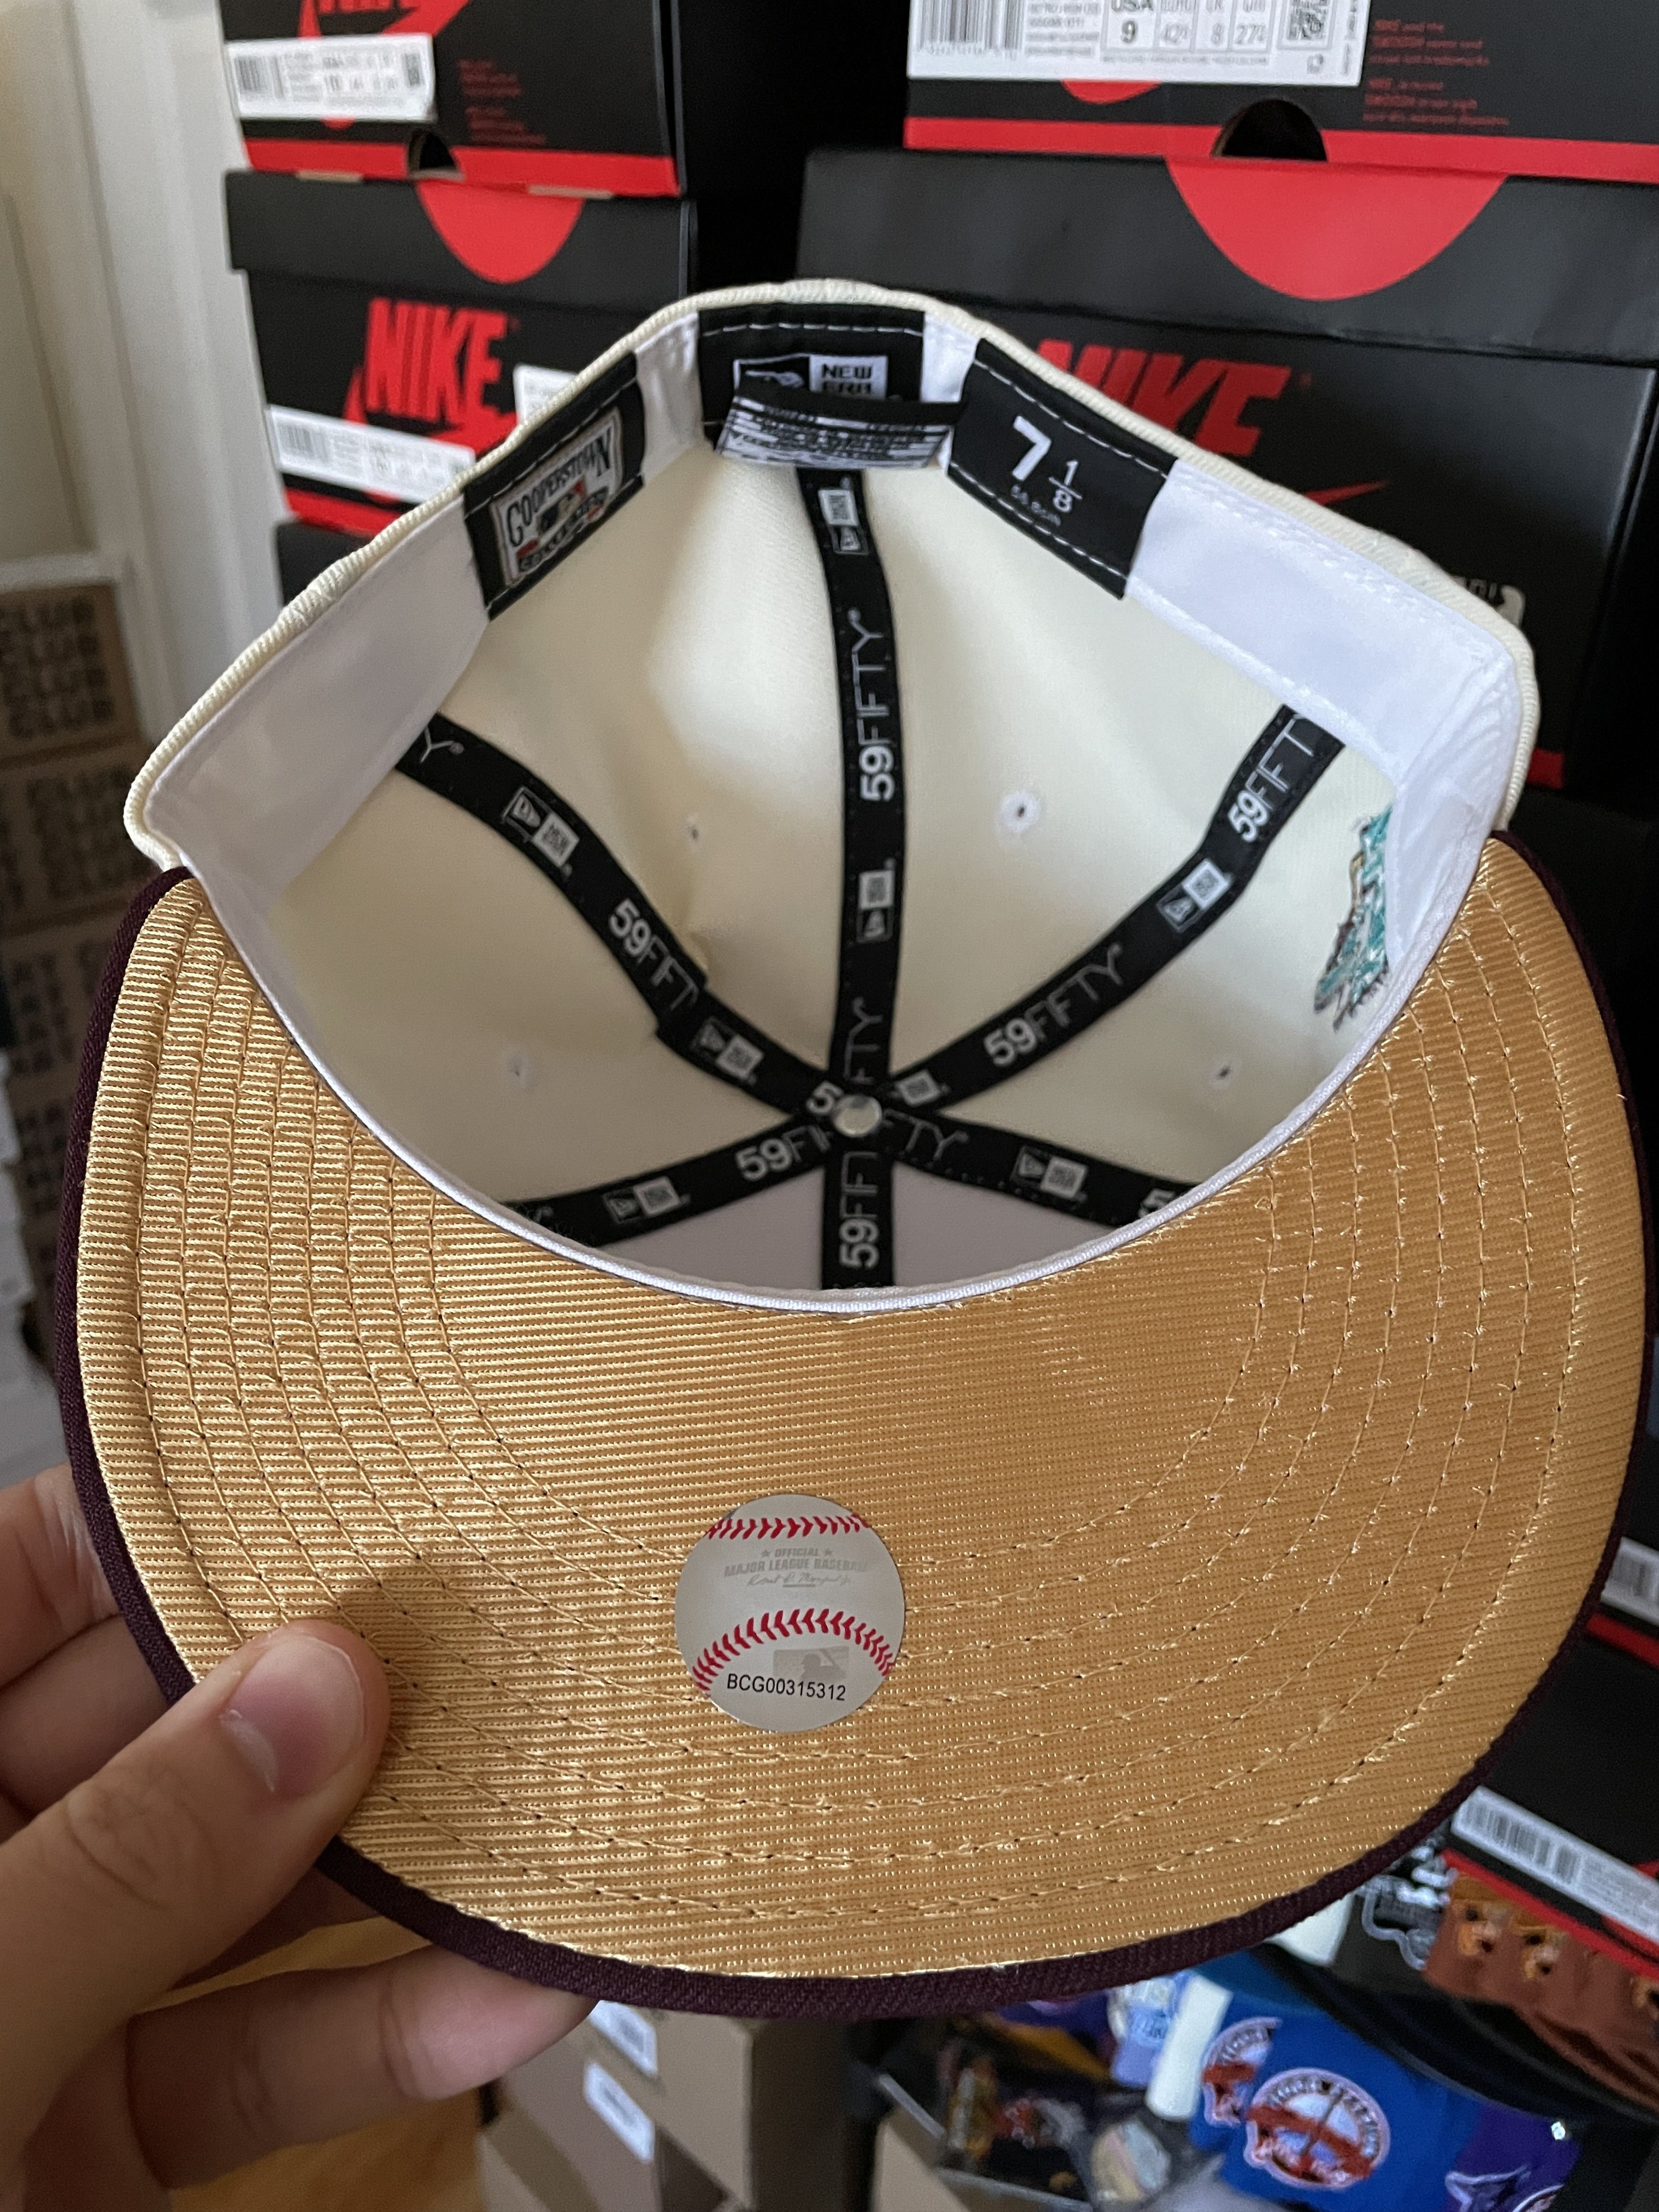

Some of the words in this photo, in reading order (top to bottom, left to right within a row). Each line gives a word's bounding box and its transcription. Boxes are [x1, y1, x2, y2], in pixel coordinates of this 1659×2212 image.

[1121, 20, 1137, 44] 9
[365, 296, 507, 427] NIKE
[821, 364, 872, 379] NEW
[1012, 415, 1052, 482] 7
[853, 609, 894, 802] 59FIFTY
[1227, 712, 1313, 842] 59FIFT
[608, 898, 699, 1011] 59FIFT
[983, 943, 1123, 1066] 59FIFTY
[724, 1561, 765, 1577] MAJOR
[769, 1558, 810, 1571] LEAGUE
[774, 1547, 819, 1558] OFFICIAL
[727, 1673, 846, 1702] BCG00315312
